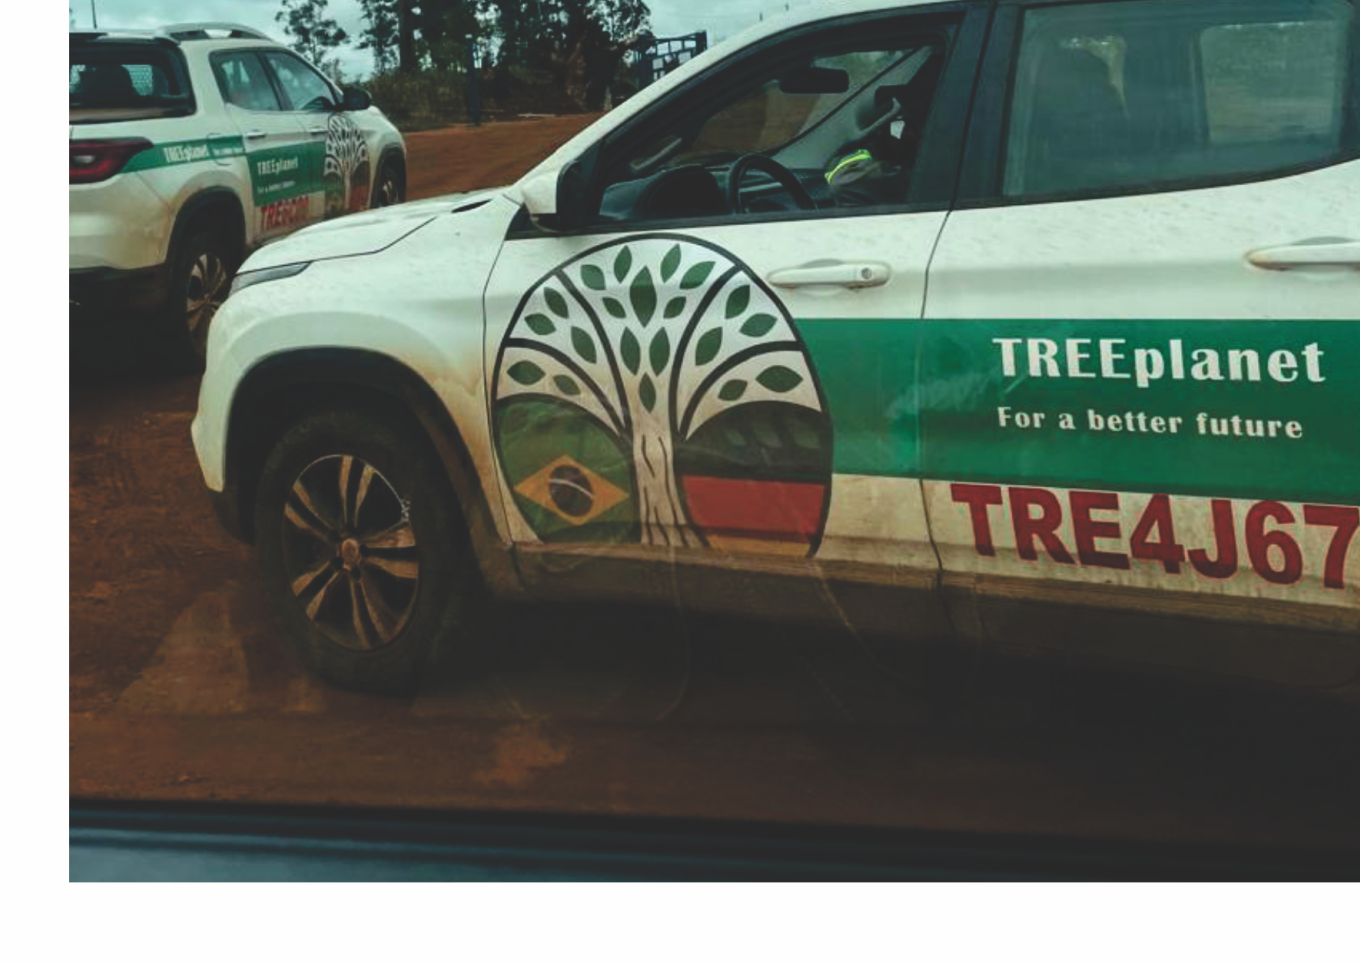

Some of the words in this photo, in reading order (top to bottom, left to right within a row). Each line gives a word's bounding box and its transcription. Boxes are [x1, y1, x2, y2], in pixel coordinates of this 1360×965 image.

[991, 337, 1327, 389] TREEplanet
[996, 405, 1046, 430] For
[1058, 410, 1077, 431] a
[1086, 406, 1183, 436] better
[1196, 410, 1304, 440] future
[950, 481, 1360, 590] TRE4J67
